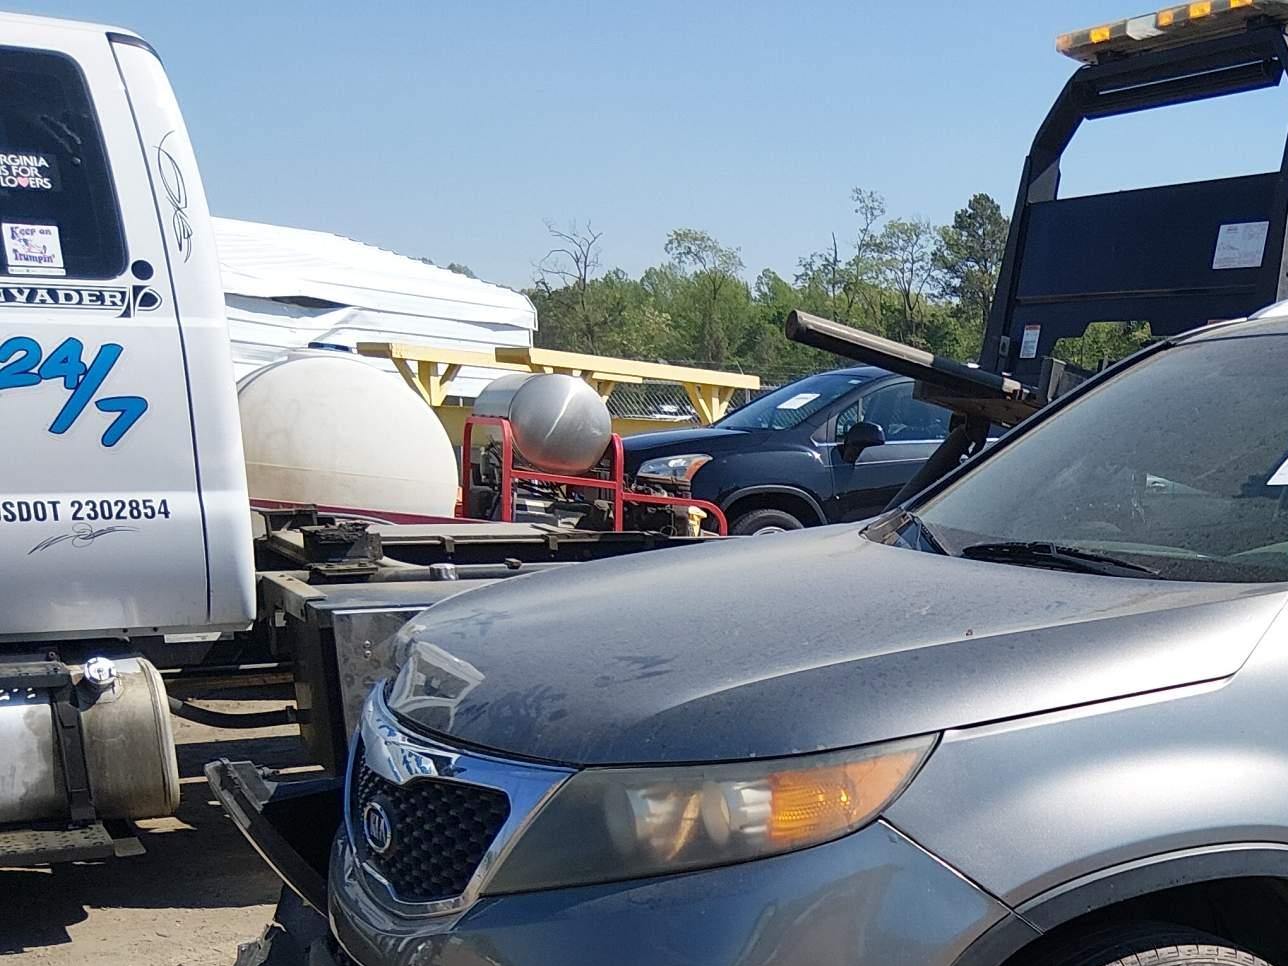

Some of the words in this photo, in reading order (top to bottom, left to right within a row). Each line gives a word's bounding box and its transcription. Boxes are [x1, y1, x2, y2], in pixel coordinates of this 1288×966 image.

[12, 166, 42, 177] FOR
[0, 335, 149, 447] 24/7
[0, 500, 60, 522] SDOT
[71, 499, 171, 521] 2302854
